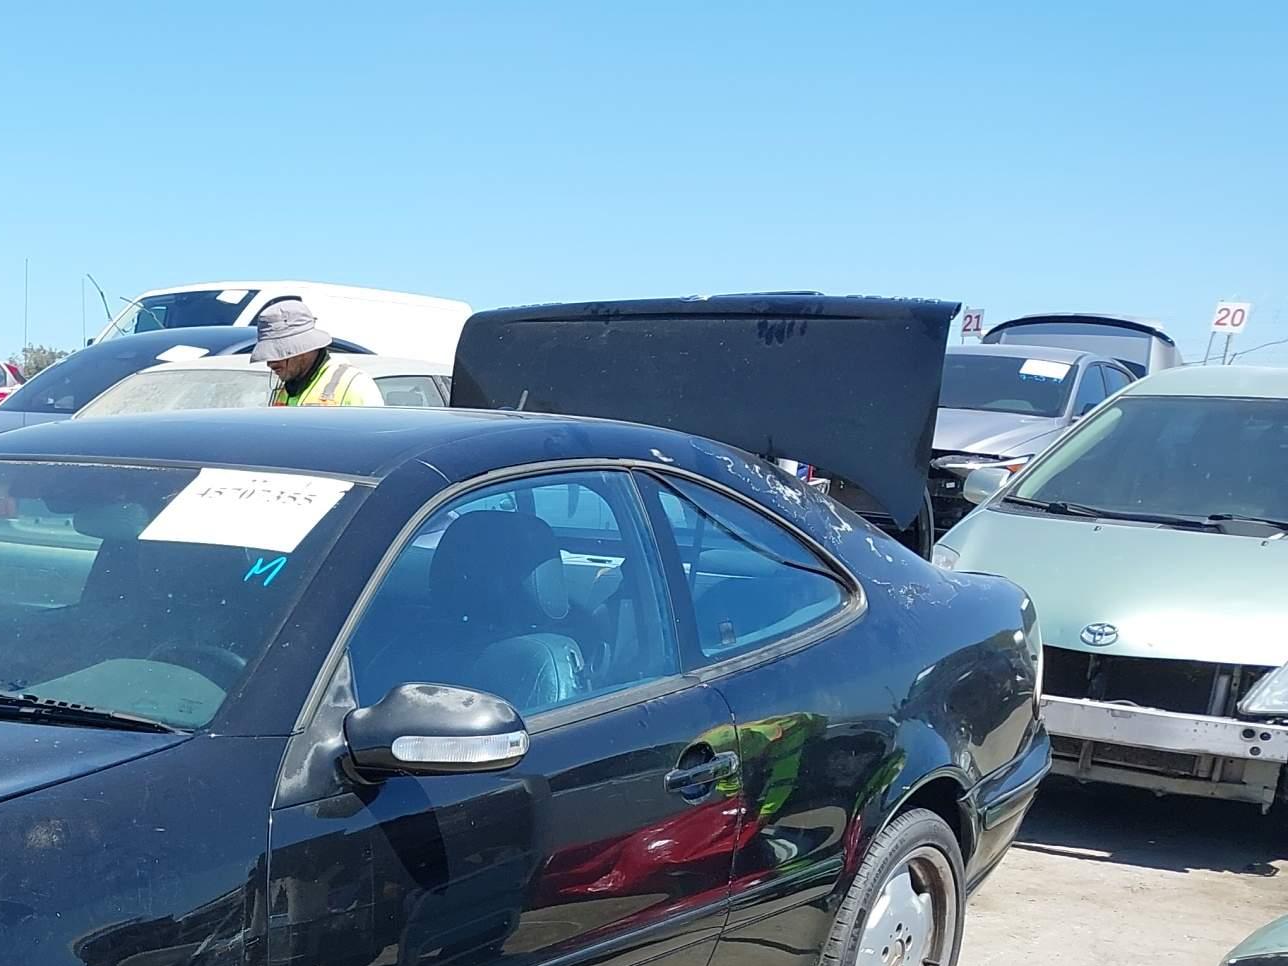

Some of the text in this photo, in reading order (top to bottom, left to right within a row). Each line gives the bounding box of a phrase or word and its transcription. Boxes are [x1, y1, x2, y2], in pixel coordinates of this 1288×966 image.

[962, 314, 982, 332] 21
[1214, 307, 1246, 327] 20
[243, 556, 287, 587] M
